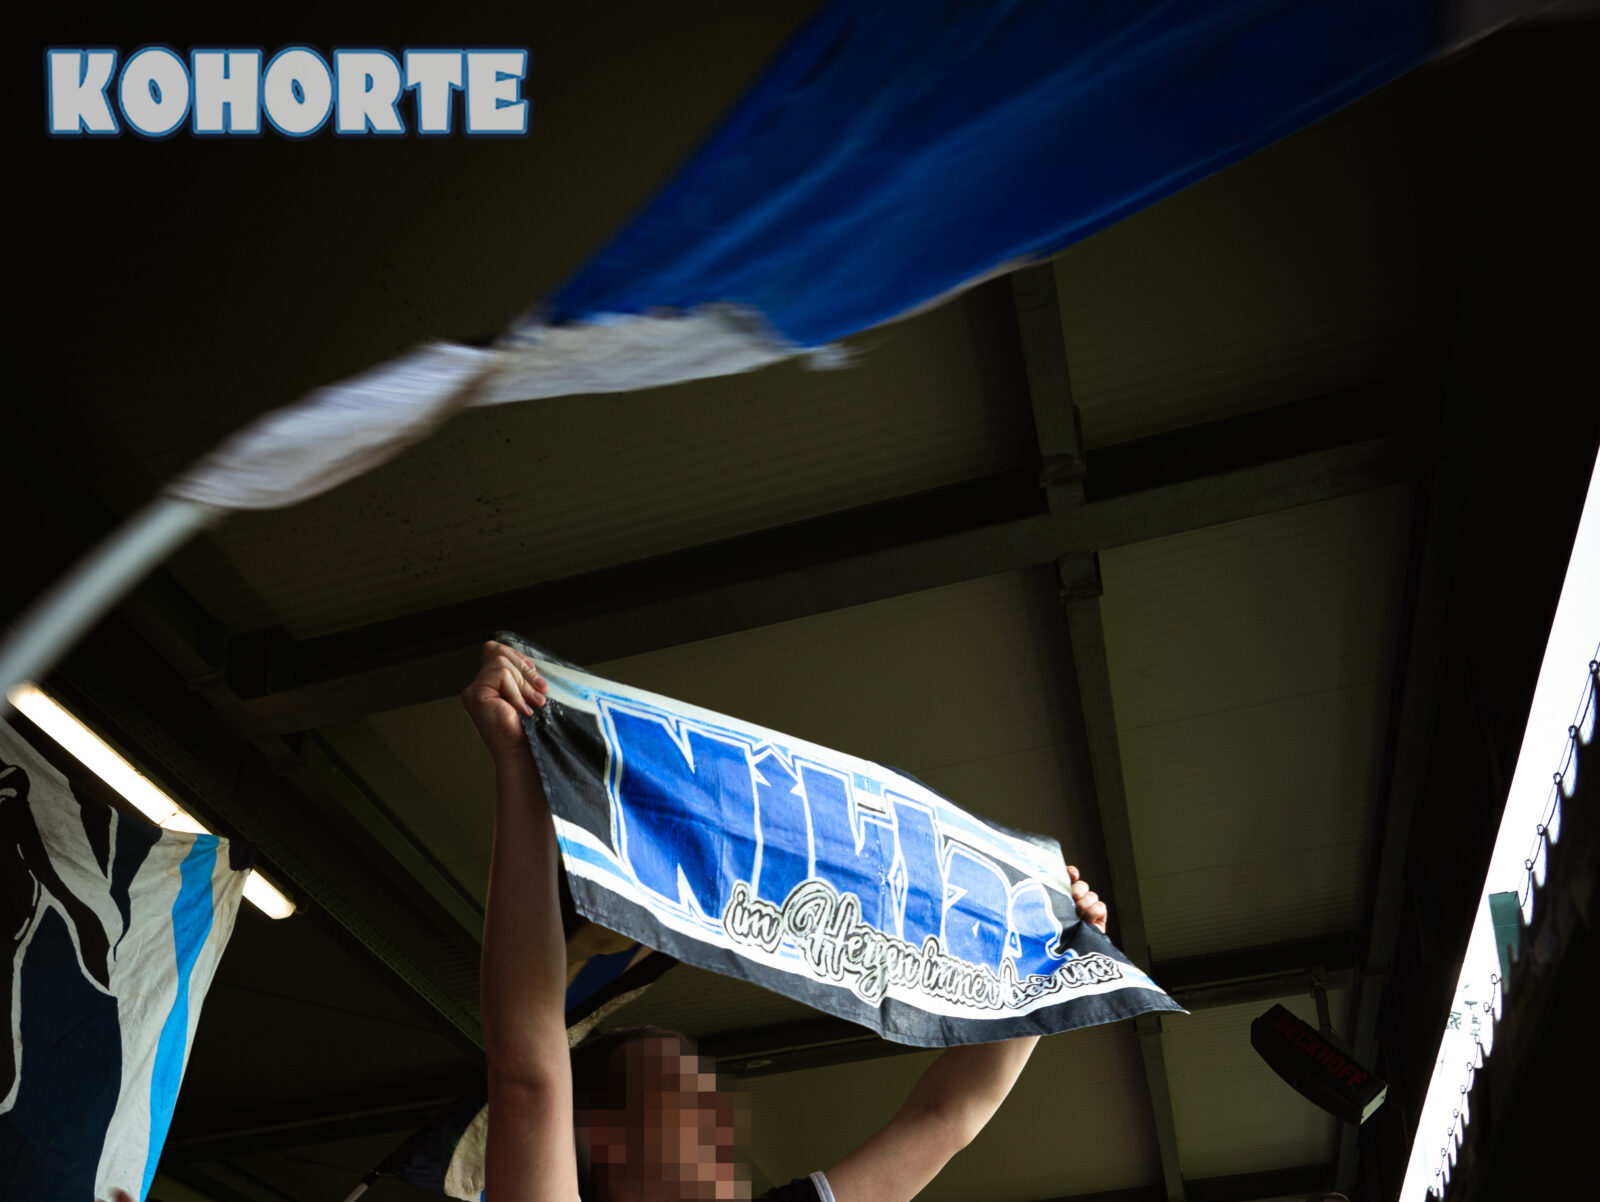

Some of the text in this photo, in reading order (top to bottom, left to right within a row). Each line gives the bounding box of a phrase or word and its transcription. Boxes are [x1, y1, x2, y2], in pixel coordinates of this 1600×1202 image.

[727, 883, 781, 951] im
[787, 884, 920, 999] Herzen
[923, 940, 1001, 1007] immer
[1061, 955, 1121, 986] uns
